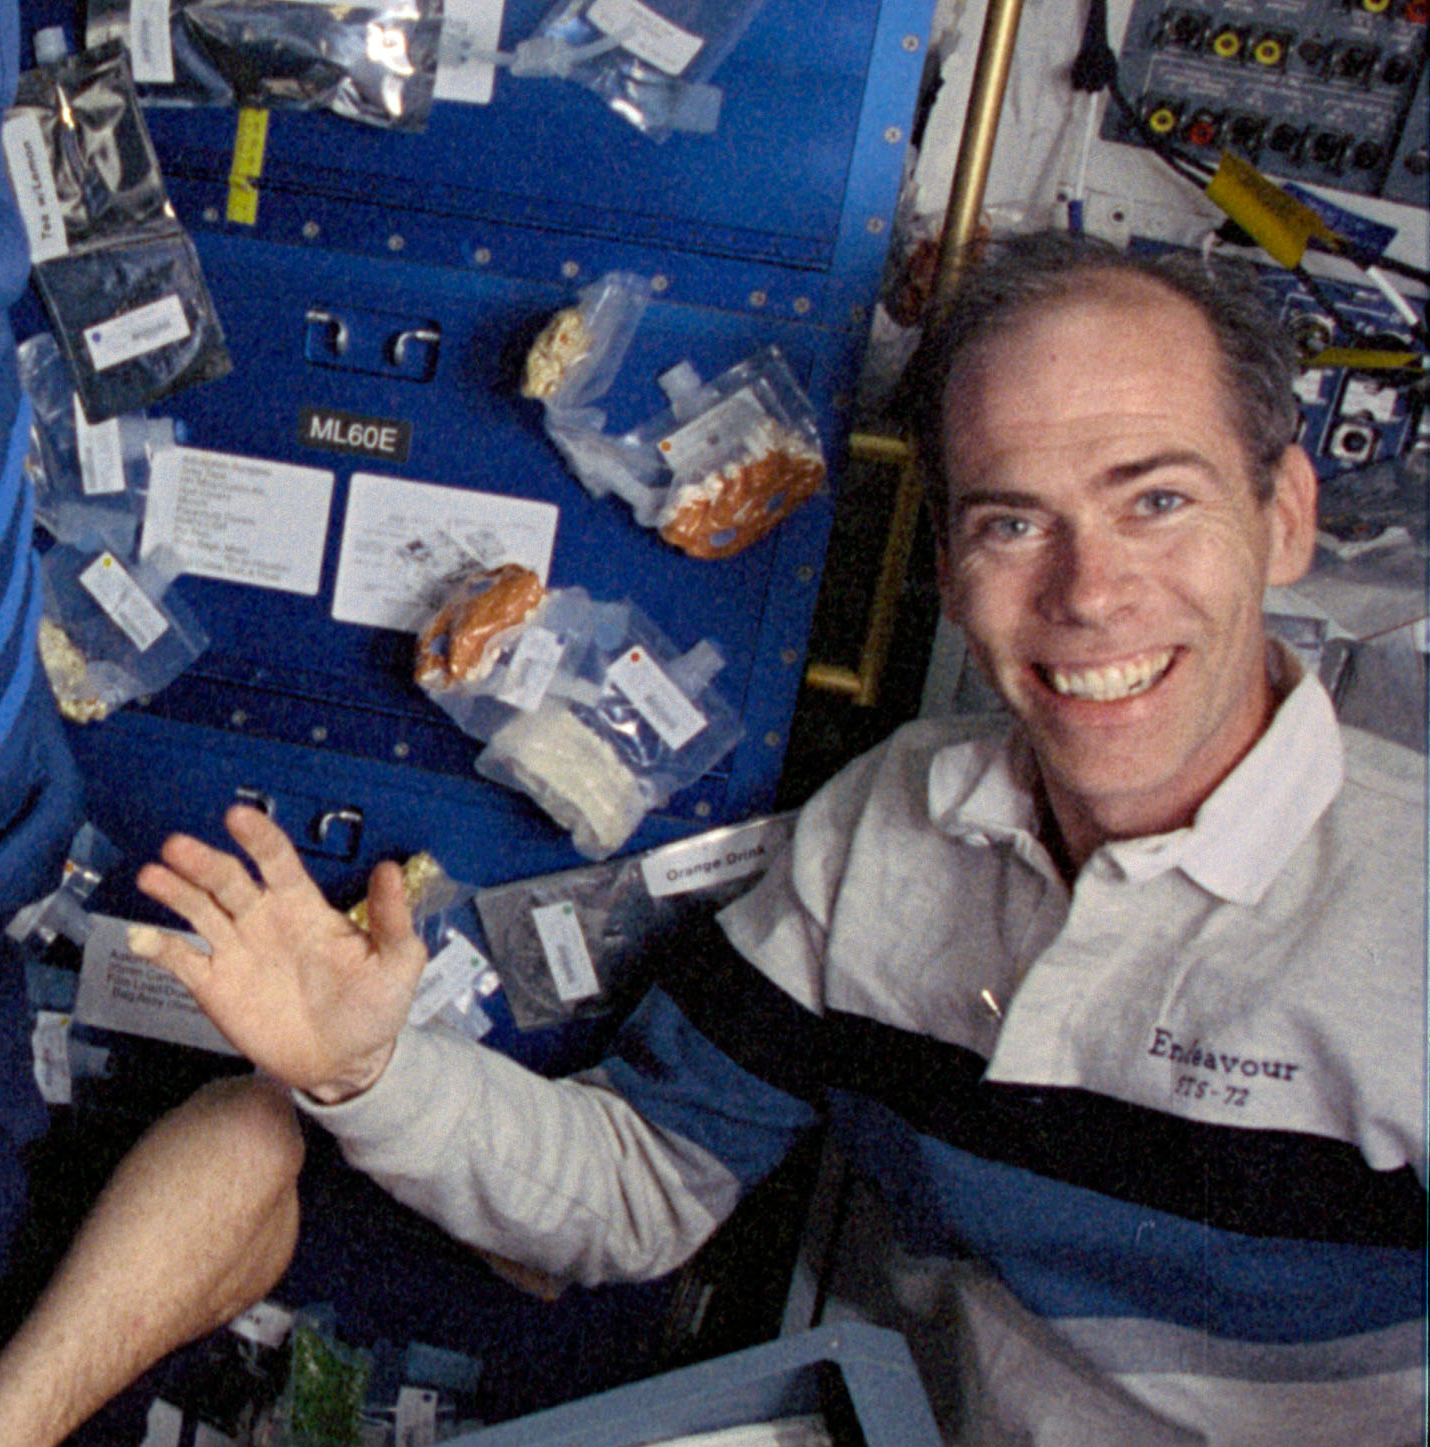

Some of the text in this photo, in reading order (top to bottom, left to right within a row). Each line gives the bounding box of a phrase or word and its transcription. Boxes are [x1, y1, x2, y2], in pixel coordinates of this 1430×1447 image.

[41, 214, 51, 241] Tea
[310, 415, 398, 452] ML60E
[666, 845, 766, 881] Orange Drink
[1148, 1027, 1300, 1082] Endeavour
